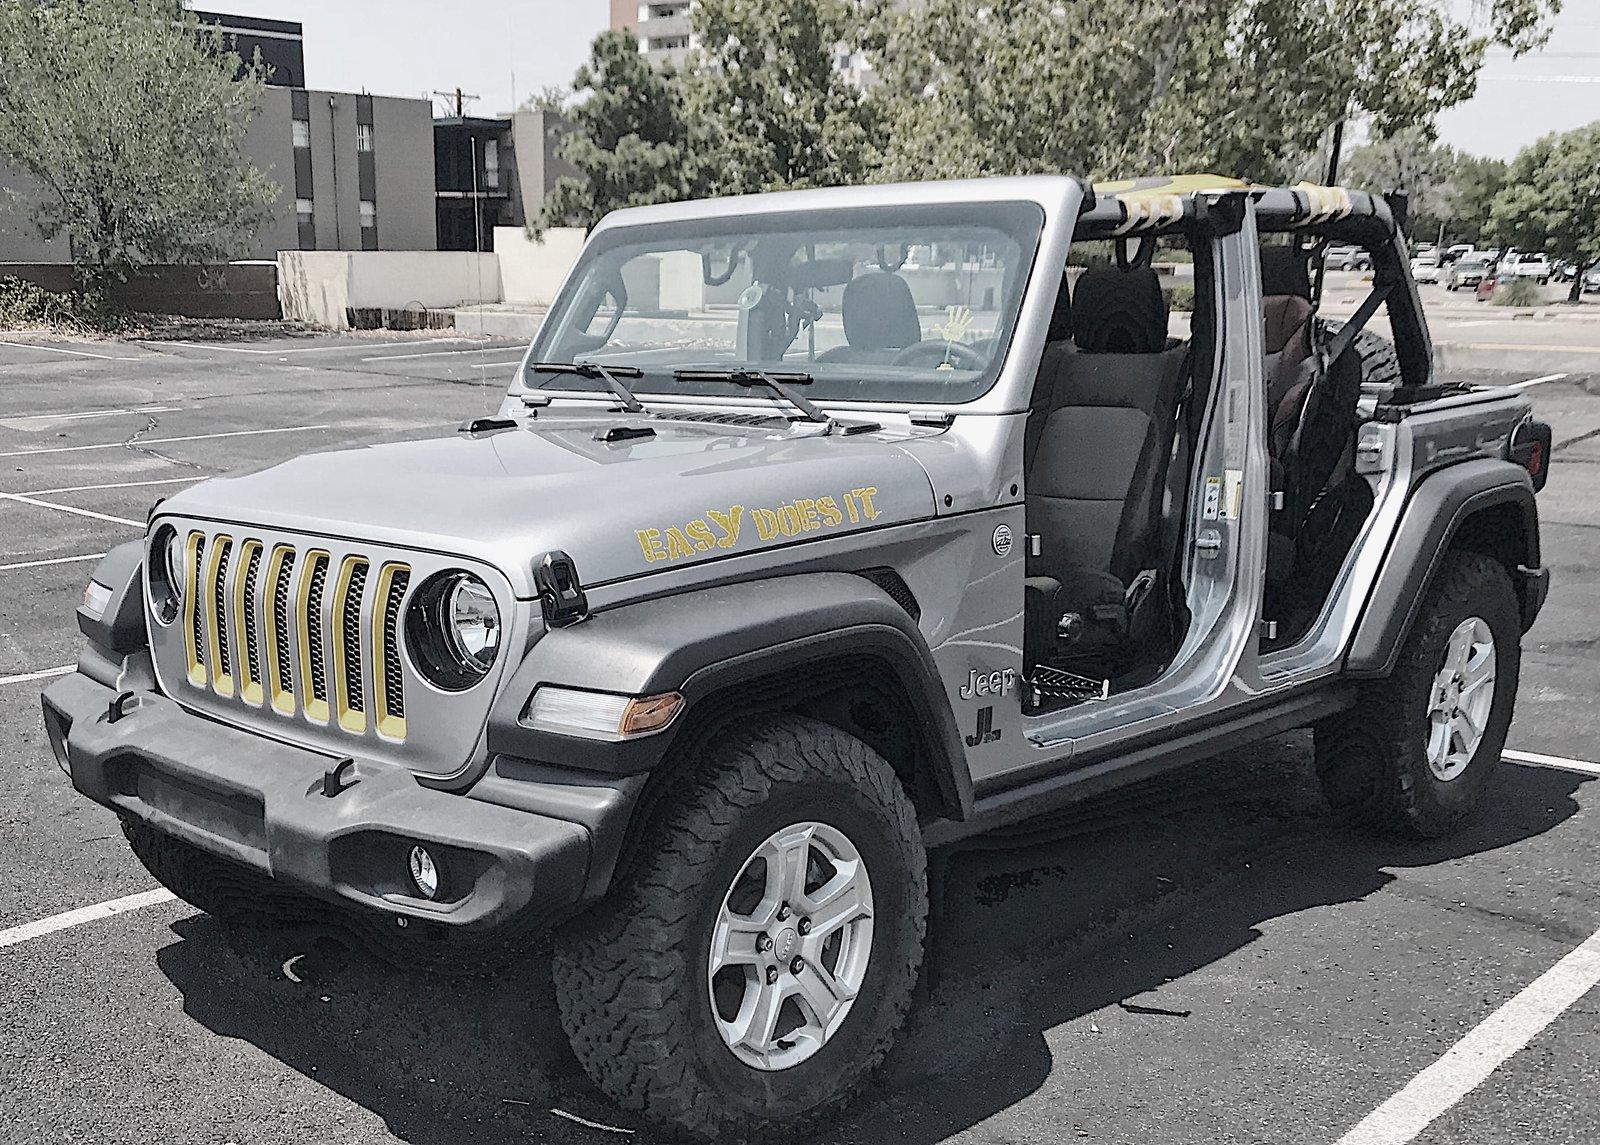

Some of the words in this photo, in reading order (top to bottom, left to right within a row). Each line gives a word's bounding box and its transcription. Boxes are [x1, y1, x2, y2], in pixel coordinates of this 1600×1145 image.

[635, 504, 745, 563] EASY
[750, 495, 843, 541] DOES
[843, 486, 882, 523] IT
[960, 667, 1016, 700] Jeep
